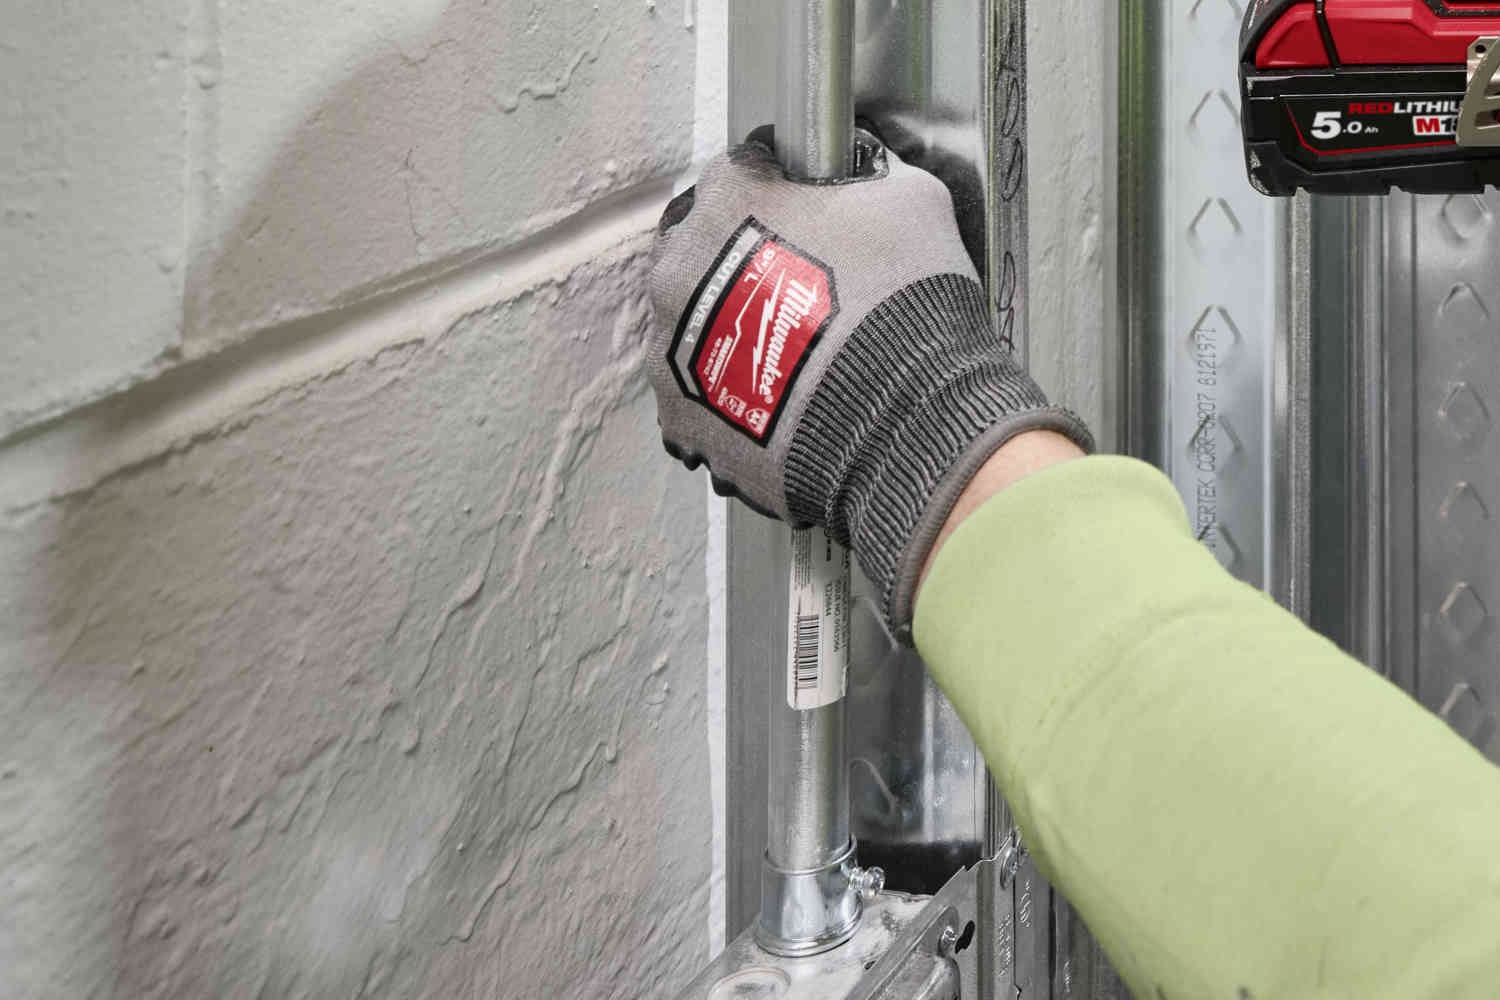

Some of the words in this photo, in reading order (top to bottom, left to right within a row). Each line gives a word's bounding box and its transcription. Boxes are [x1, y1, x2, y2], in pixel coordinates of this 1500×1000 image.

[1348, 101, 1461, 115] REDLITHIU
[1310, 111, 1363, 140] 5.0
[1364, 125, 1380, 134] Ah
[716, 251, 742, 282] CUT
[689, 285, 720, 330] LEVEL
[684, 333, 695, 344] 4
[758, 278, 818, 399] Milwaukee
